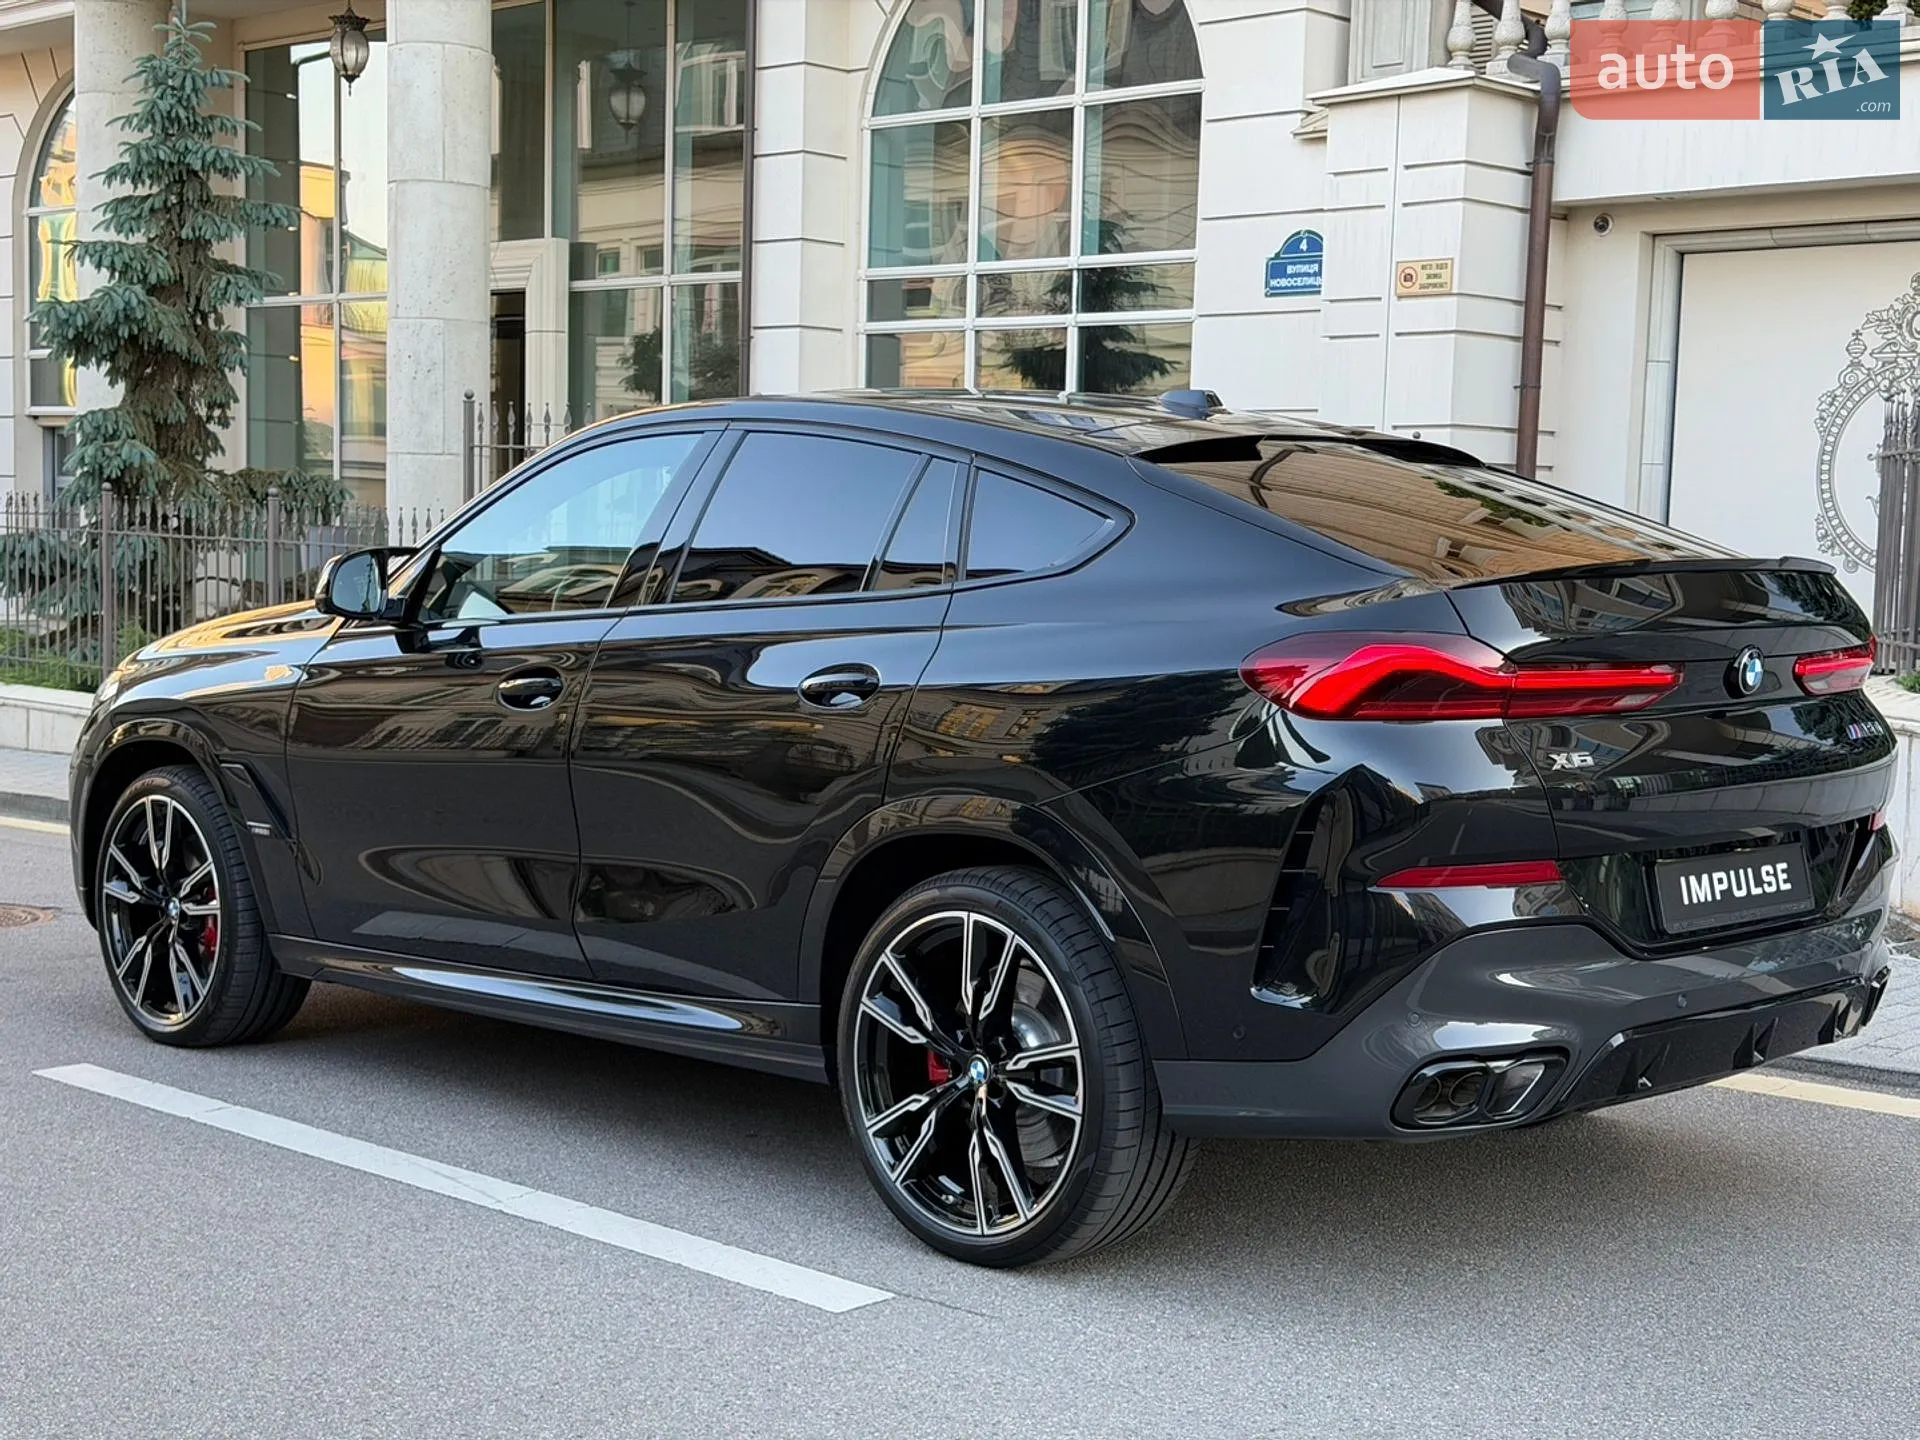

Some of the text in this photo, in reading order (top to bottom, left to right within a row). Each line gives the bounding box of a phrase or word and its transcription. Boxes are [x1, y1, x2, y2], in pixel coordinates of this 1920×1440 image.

[1299, 238, 1308, 252] 4
[1286, 264, 1319, 275] ВУЛИЦЯ
[1548, 751, 1595, 771] X6
[1680, 862, 1792, 905] IMPULSE
